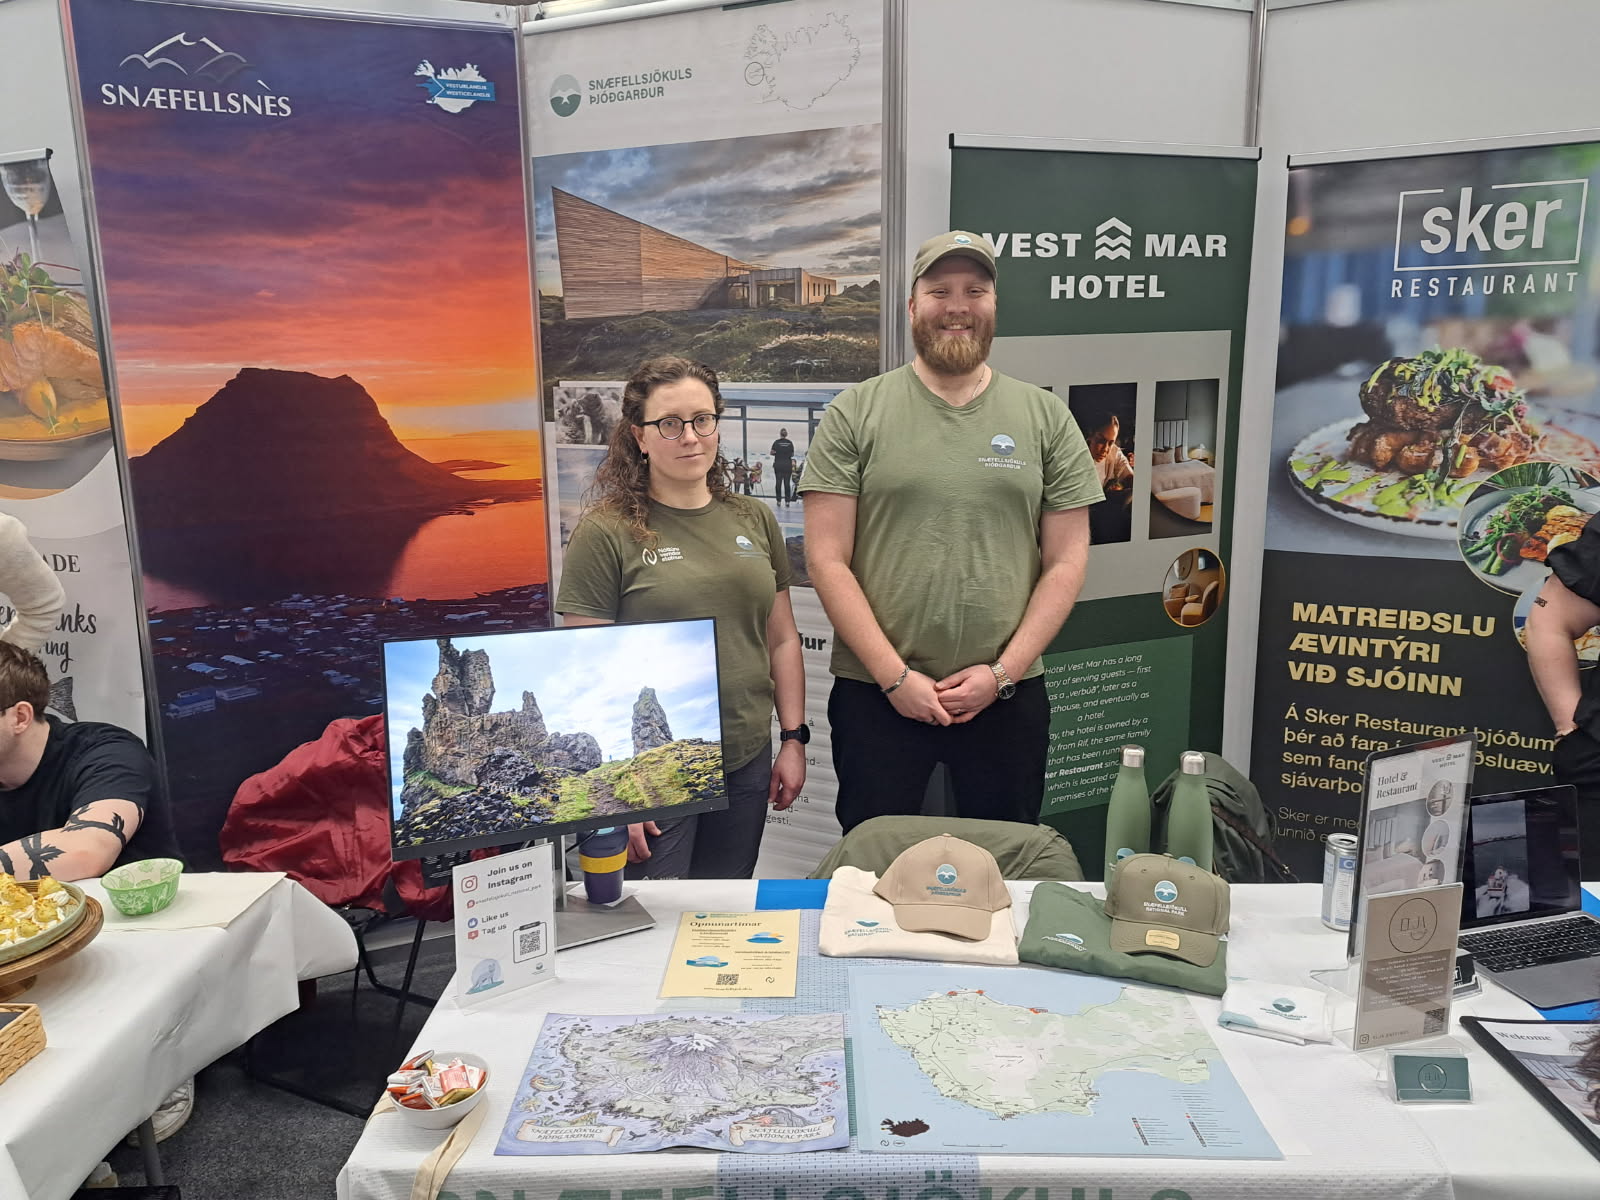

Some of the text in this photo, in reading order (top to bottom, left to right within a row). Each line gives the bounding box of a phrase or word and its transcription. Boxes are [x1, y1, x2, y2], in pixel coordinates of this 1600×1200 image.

[588, 67, 693, 91] SNÆFELLSJÖKULS
[589, 86, 665, 105] ÞJÓÐGARÐUR
[1420, 186, 1564, 255] sker
[981, 232, 1227, 258] VEST MAR
[1050, 274, 1166, 299] HOTEL
[1391, 272, 1579, 299] RESTAURANT
[1292, 601, 1496, 637] MATREIÐSLU
[1289, 635, 1441, 664] ÆVINTÝRI
[1068, 662, 1084, 671] Vest
[1086, 660, 1101, 668] Mar
[1102, 658, 1116, 666] has
[1124, 654, 1142, 663] long
[1063, 677, 1071, 685] of
[1072, 673, 1100, 684] serving
[1101, 670, 1126, 680] guests
[1136, 666, 1152, 674] first
[1288, 661, 1463, 697] VIÐ SJÓINN
[1102, 683, 1120, 692] later
[1082, 699, 1098, 708] and
[1100, 692, 1139, 705] eventually
[1284, 702, 1299, 721] Á
[1304, 707, 1350, 726] Sker
[1062, 730, 1074, 738] the
[1076, 724, 1096, 734] hotel
[1104, 719, 1130, 730] owned
[1132, 718, 1141, 726] by
[1057, 742, 1076, 751] from
[1090, 737, 1103, 745] the
[1105, 734, 1125, 742] same
[1127, 728, 1152, 739] family
[1283, 726, 1317, 745] þér
[1320, 732, 1346, 748] að
[1351, 735, 1390, 752] fara
[1048, 757, 1064, 766] that
[1066, 754, 1080, 762] has
[1082, 751, 1100, 760] been
[1282, 751, 1322, 768] sem
[1059, 762, 1103, 776] Restaurant
[1048, 782, 1070, 792] which
[1080, 774, 1107, 784] located
[1377, 772, 1399, 786] Hotel
[1050, 791, 1086, 805] premises
[1087, 788, 1096, 796] of
[1096, 786, 1109, 795] the
[1376, 782, 1418, 799] Restaurant
[1279, 806, 1310, 823] Sker
[1314, 814, 1330, 825] er
[1277, 826, 1316, 841] unnið
[487, 867, 506, 877] Join
[508, 864, 520, 872] us
[488, 873, 533, 889] Instagram
[482, 914, 498, 924] Like
[1494, 1030, 1552, 1041] Welcome
